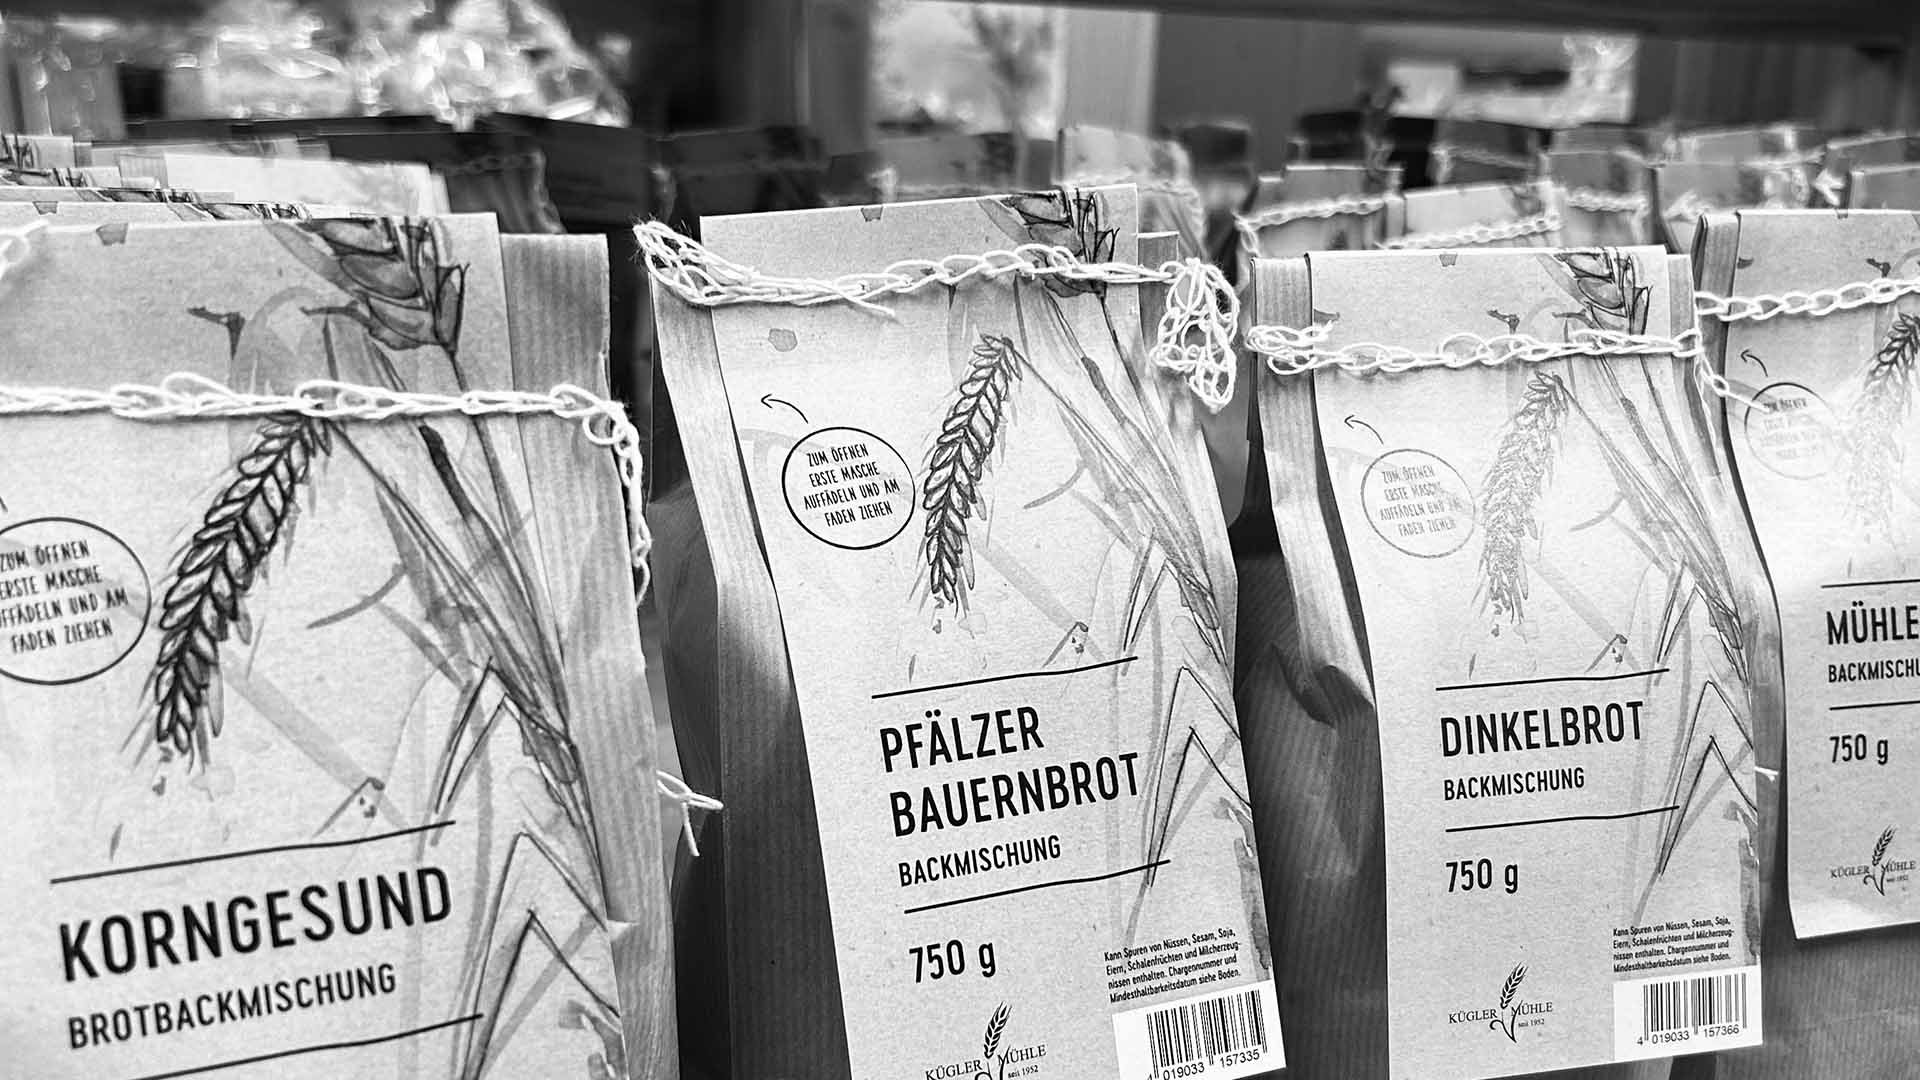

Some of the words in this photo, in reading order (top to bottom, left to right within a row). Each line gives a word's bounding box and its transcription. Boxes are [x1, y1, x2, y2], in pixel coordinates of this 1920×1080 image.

[806, 450, 829, 467] ZUM
[831, 443, 869, 463] ÖFFNEN
[808, 470, 838, 488] ERSTE
[840, 461, 880, 481] MASCHE
[803, 488, 857, 510] AUFFÄDELN
[858, 482, 880, 499] UND
[883, 478, 901, 495] AM
[824, 508, 856, 527] FADEN
[858, 500, 893, 520] ZIEHEN
[0, 550, 30, 572] ZUM
[45, 565, 103, 590] MASCHE
[0, 599, 63, 628] FFÄDELN
[69, 593, 99, 615] UND
[106, 587, 128, 608] AM
[1826, 601, 1920, 645] MÜHLE
[11, 629, 57, 653] FADEN
[64, 618, 113, 644] ZIEHEN
[879, 706, 1044, 773] PFÄLZER
[1440, 701, 1644, 757] DINKELBROT
[1829, 734, 1867, 763] 750
[1877, 737, 1889, 765] g
[889, 752, 1139, 838] BAUERNBROT
[1443, 767, 1585, 800] BACKMISCHUNG
[898, 835, 1061, 887] BACKMISCHUNG
[1445, 858, 1492, 893] 750
[1504, 863, 1518, 894] g
[59, 866, 452, 983] KORNGESUND
[908, 939, 966, 984] 750
[978, 942, 996, 978] g
[1104, 951, 1122, 962] Kann
[1123, 946, 1148, 958] Spuren
[1148, 943, 1162, 953] von
[1163, 937, 1191, 950] Nüssen,
[1191, 931, 1217, 943] Sesam,
[1184, 948, 1198, 959] und
[1108, 976, 1130, 989] nissen
[1224, 953, 1237, 965] und
[1198, 973, 1216, 985] siehe
[68, 963, 396, 1049] BROTBACKMISCHUNG
[1449, 1008, 1498, 1024] KÜGLER
[1511, 1001, 1553, 1017] MÜHLE
[1652, 1030, 1690, 1045] 019033
[1703, 1023, 1739, 1038] 157366
[925, 1060, 983, 1080] KÜGLER
[997, 1044, 1047, 1066] MÜHLE
[1021, 1064, 1039, 1075] 1952
[1163, 1062, 1205, 1080] 019033
[1220, 1048, 1260, 1068] 157335
